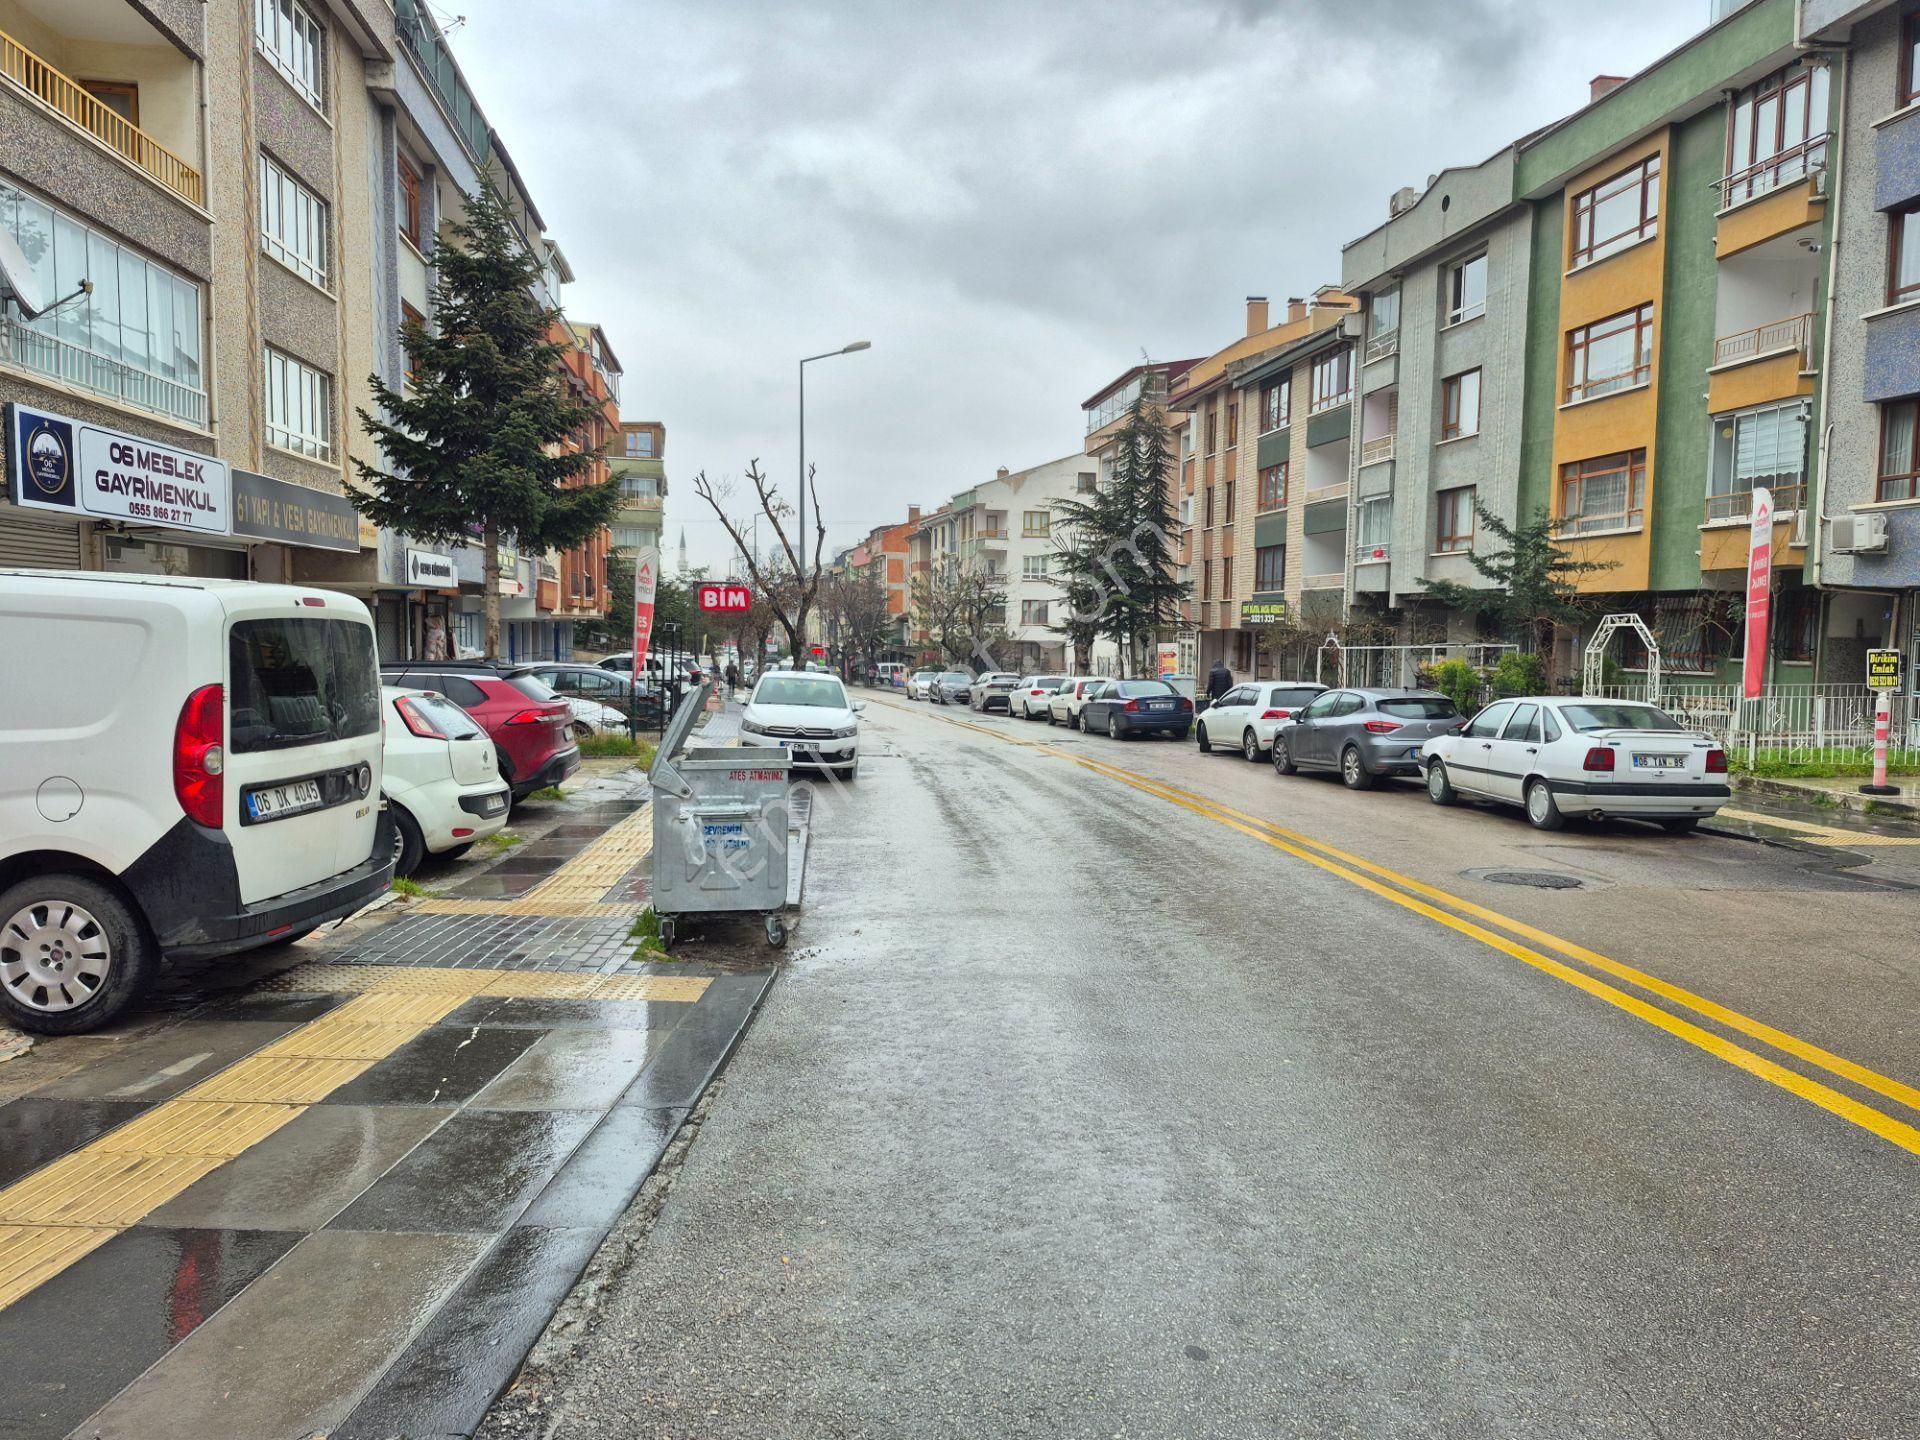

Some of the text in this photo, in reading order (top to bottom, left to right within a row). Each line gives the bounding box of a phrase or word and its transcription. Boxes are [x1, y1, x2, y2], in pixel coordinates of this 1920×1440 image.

[44, 460, 52, 468] 06
[110, 442, 205, 483] 06 MESLEK
[95, 469, 217, 512] GAYRİMENKUL
[129, 502, 192, 524] 0555 866 27 77
[237, 492, 249, 522] 61
[704, 588, 746, 607] BİM
[1870, 653, 1897, 663] Birikim
[1872, 664, 1895, 673] Emlak
[1639, 757, 1648, 766] 06
[254, 792, 271, 813] 06
[274, 787, 291, 808] DK
[294, 782, 320, 803] 4045
